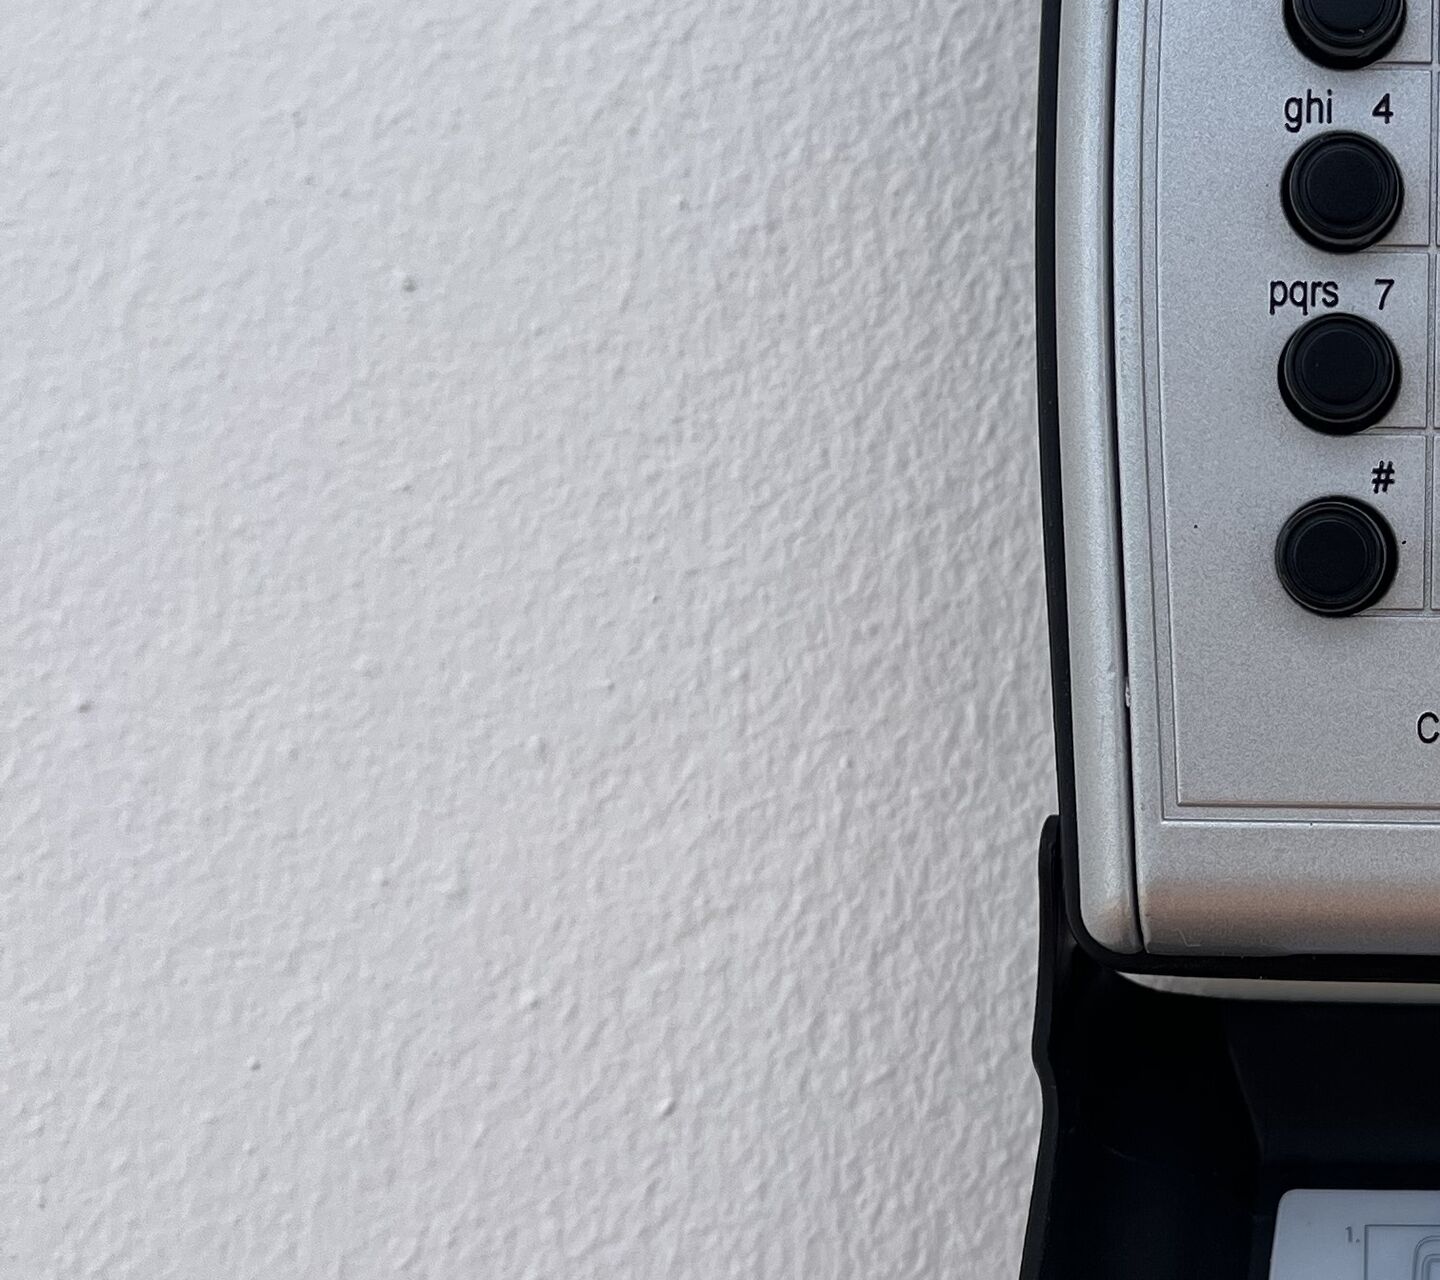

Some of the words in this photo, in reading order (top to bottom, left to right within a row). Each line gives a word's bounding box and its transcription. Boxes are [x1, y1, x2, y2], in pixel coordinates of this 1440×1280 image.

[1284, 88, 1333, 133] ghi
[1371, 92, 1394, 125] 4
[1269, 279, 1340, 316] pqrs
[1374, 278, 1395, 311] 7
[1371, 460, 1396, 495] #
[1416, 711, 1440, 744] C
[1345, 1225, 1361, 1243] 1.
